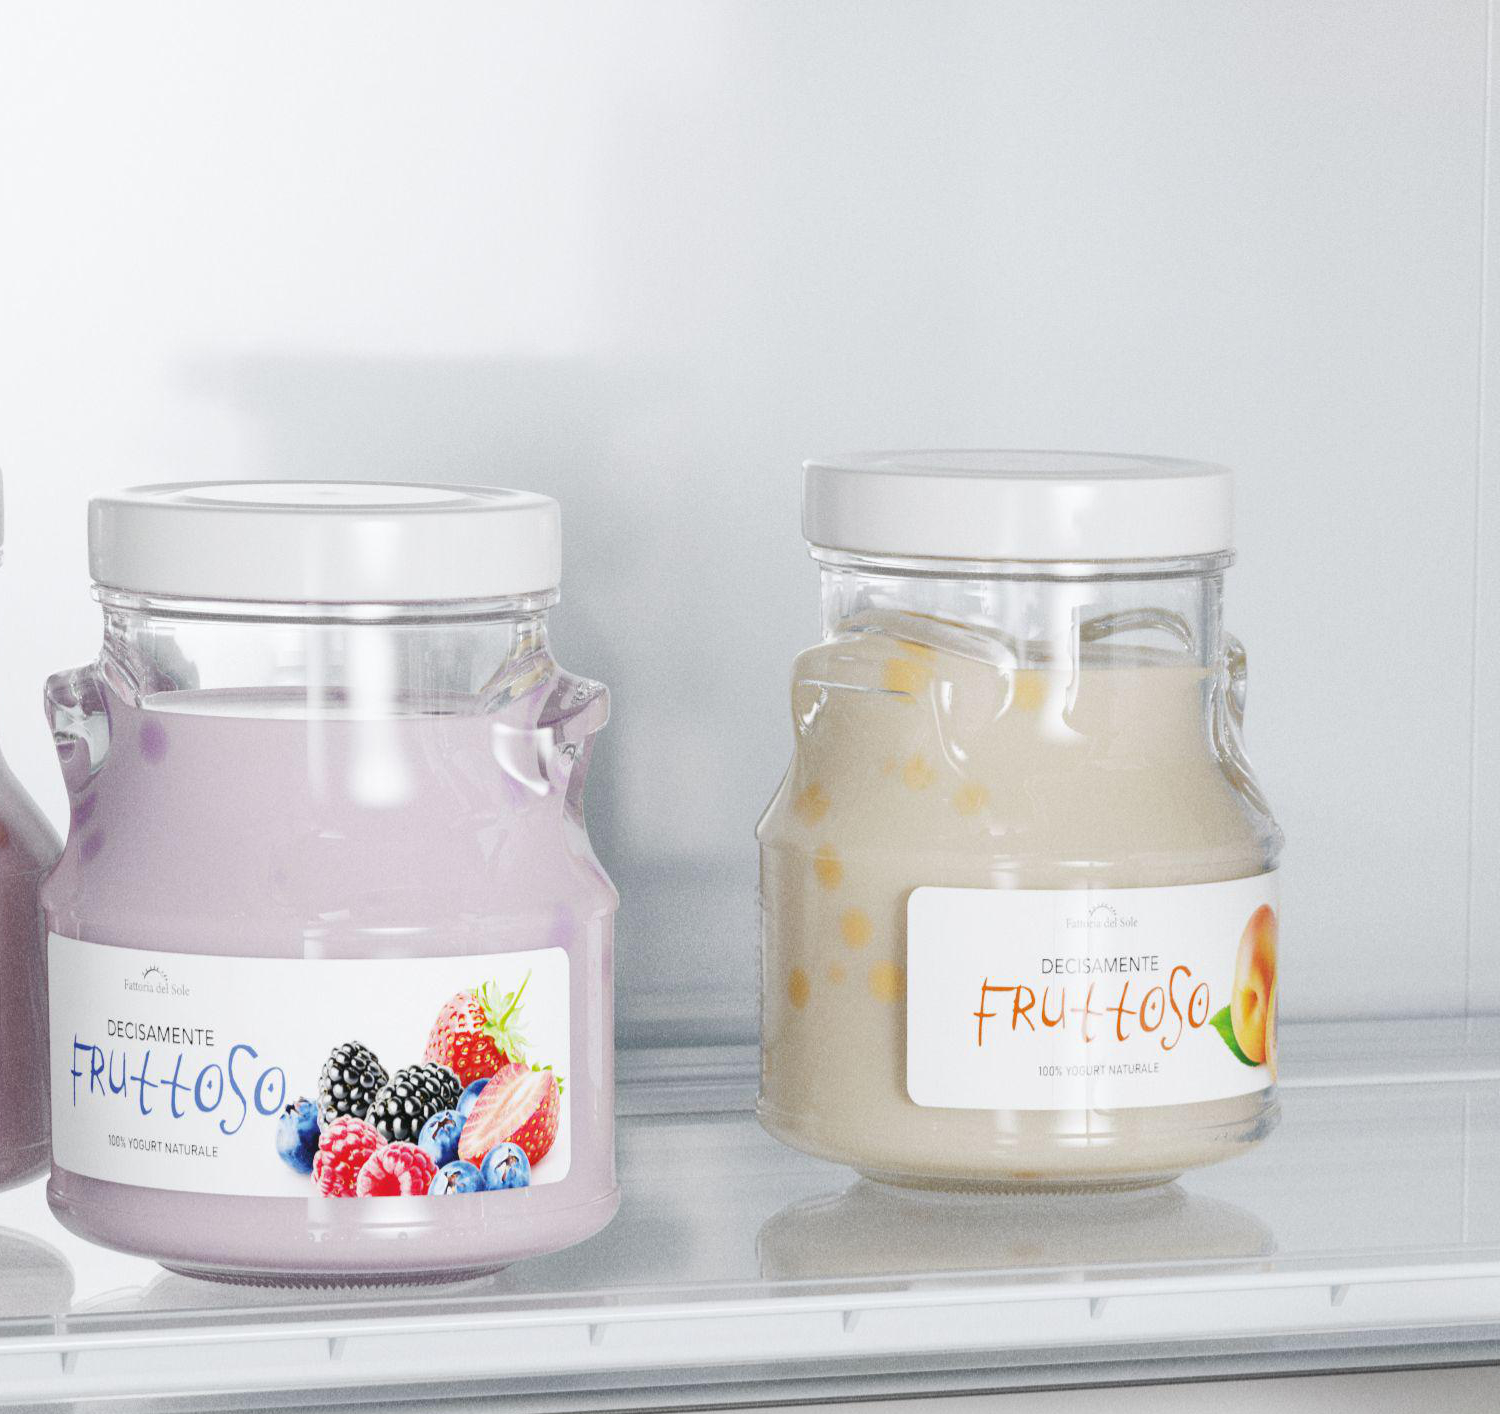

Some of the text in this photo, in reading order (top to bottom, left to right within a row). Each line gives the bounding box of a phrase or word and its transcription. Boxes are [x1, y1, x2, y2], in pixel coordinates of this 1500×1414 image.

[1120, 916, 1138, 928] Sole
[1041, 956, 1159, 975] DECISAMENTE
[124, 978, 190, 996] Fattoria del Sole
[107, 1019, 214, 1046] DECISAMENTE
[1038, 1062, 1159, 1076] 100% YOGURT NATURALE
[108, 1134, 218, 1158] 100% YOGURT NATURALE
